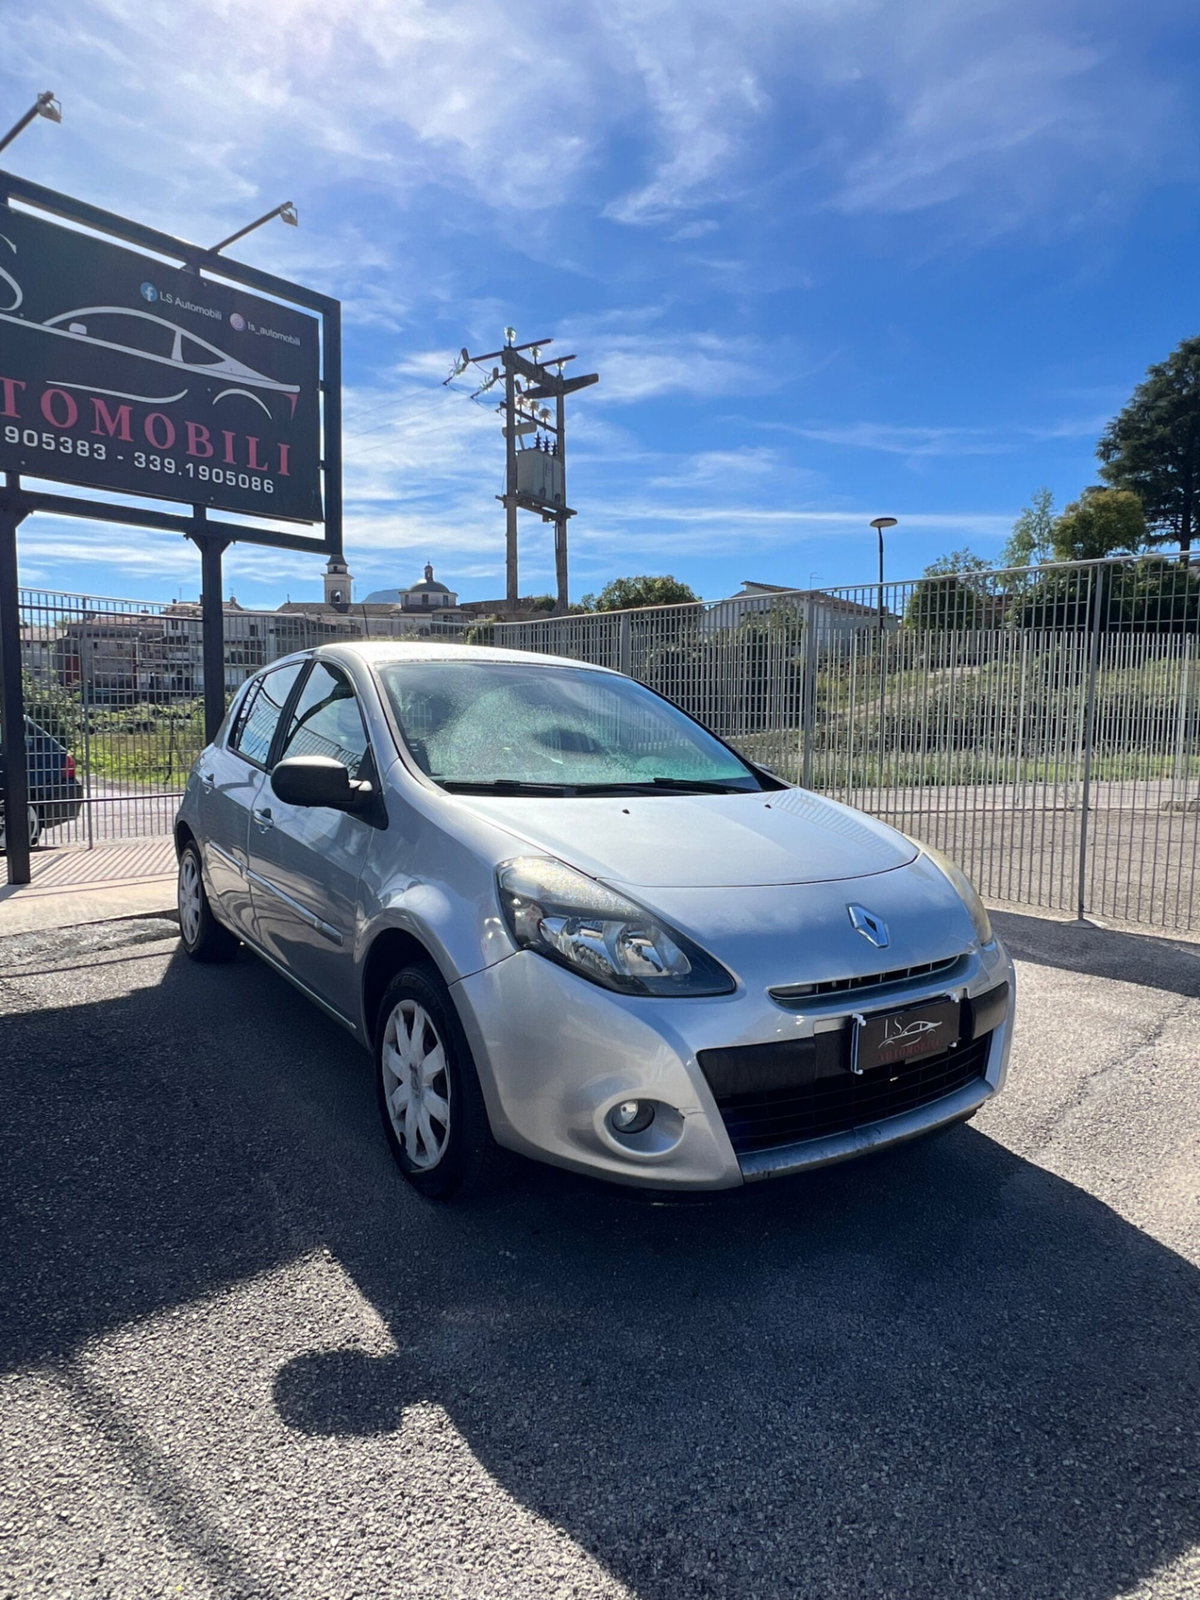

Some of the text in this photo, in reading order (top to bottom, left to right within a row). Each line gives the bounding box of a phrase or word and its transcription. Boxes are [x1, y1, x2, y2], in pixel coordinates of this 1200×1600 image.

[159, 291, 222, 321] LS Automobili
[0, 376, 291, 477] TOMOBILI
[4, 425, 107, 461] 905383
[134, 451, 275, 494] 339.1905086
